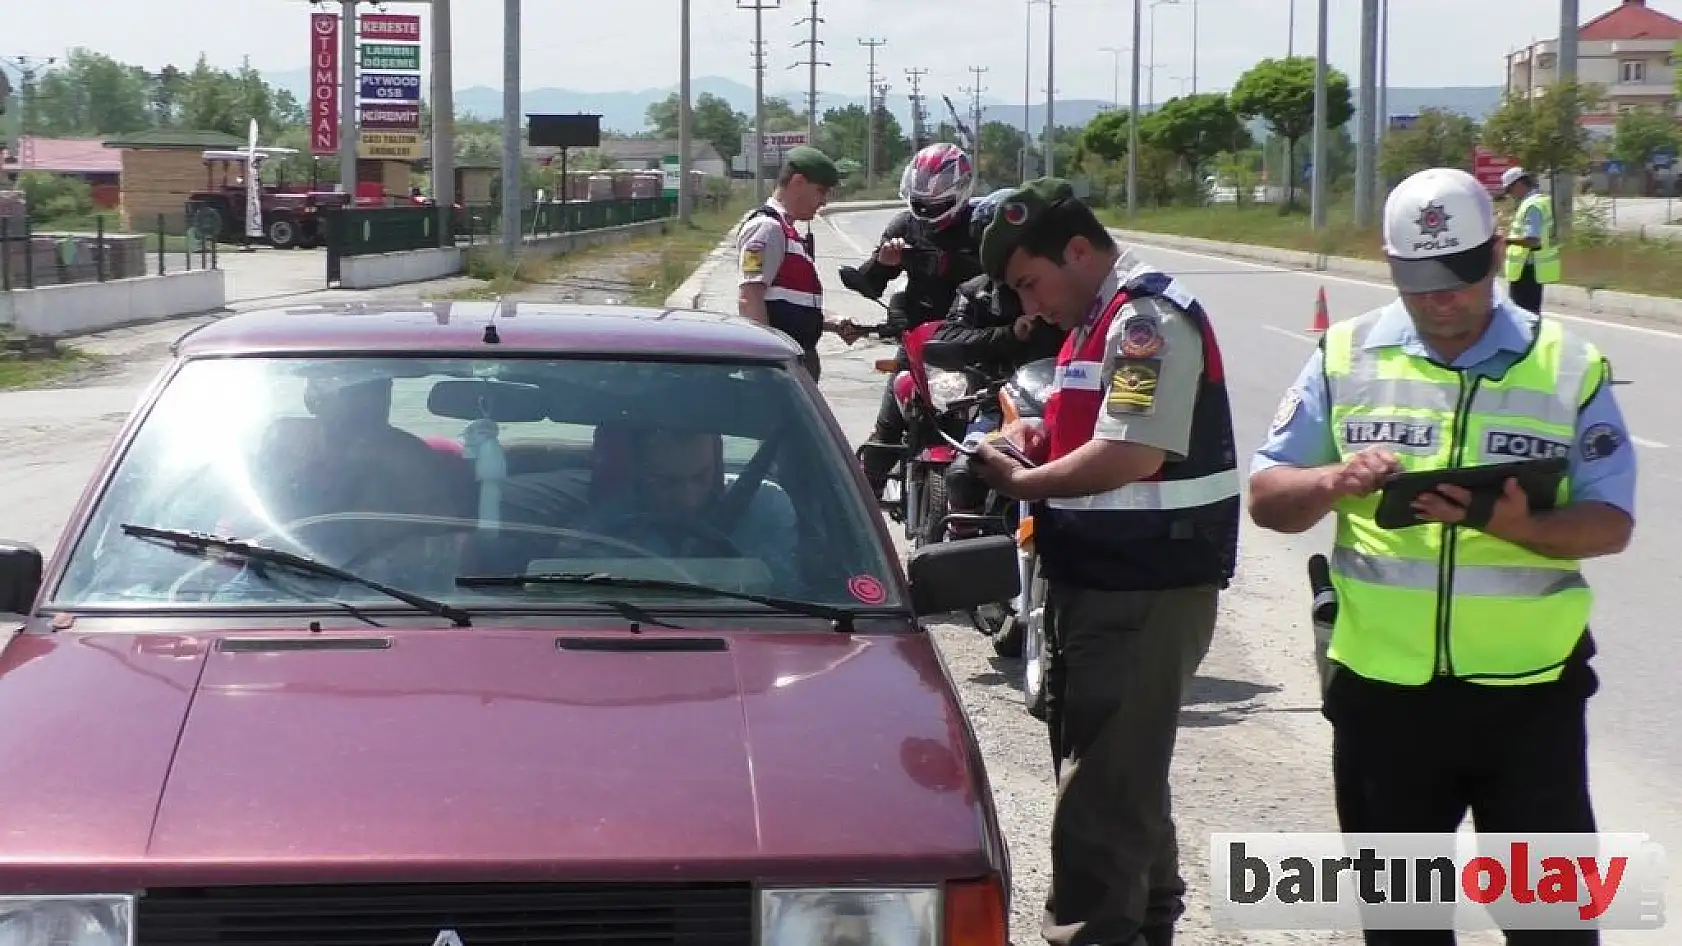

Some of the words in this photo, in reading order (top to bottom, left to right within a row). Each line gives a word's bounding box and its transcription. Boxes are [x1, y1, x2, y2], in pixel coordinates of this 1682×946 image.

[362, 20, 418, 34] KERESTE
[362, 76, 418, 86] PLYWOOD
[376, 87, 403, 98] OSB
